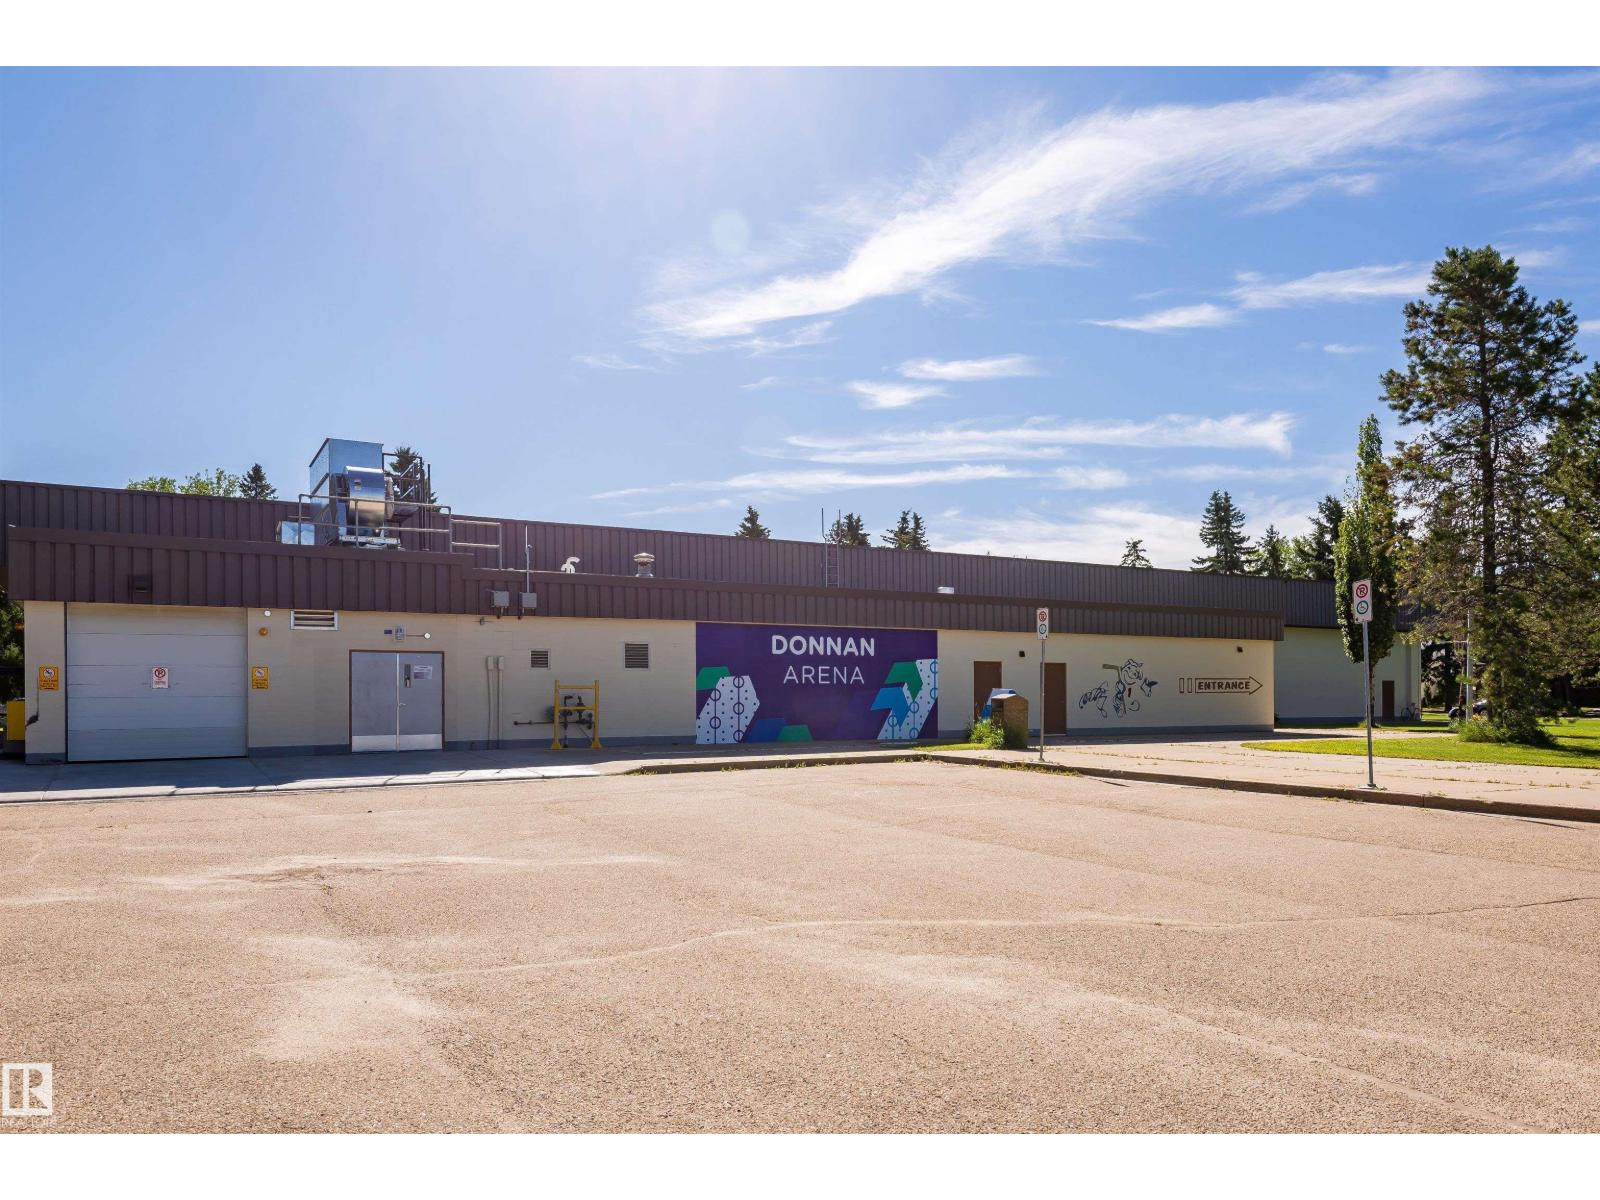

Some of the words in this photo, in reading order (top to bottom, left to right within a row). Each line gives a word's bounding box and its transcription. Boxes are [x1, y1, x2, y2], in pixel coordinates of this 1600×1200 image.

[771, 635, 876, 657] DONNAN
[783, 665, 865, 685] ARENA
[1197, 681, 1251, 692] ENTRANCE
